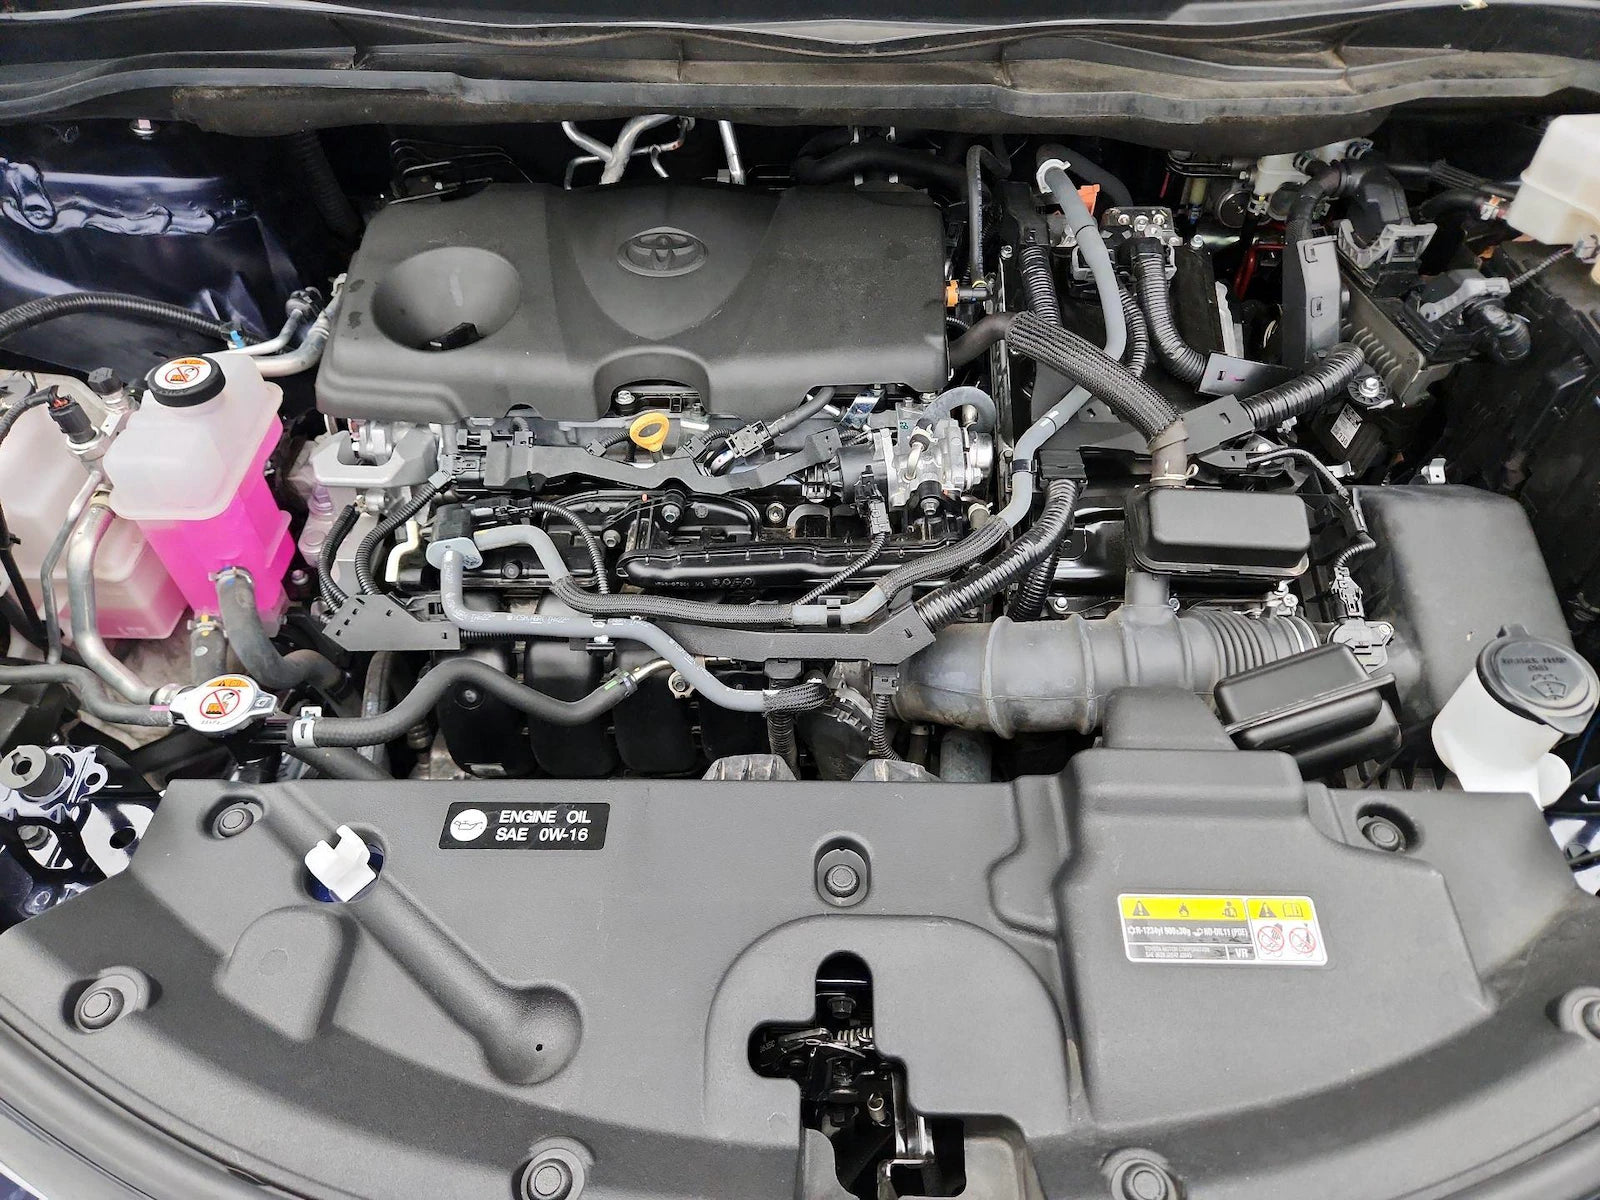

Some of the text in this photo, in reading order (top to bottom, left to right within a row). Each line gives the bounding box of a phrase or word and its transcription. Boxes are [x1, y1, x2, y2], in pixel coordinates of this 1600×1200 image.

[498, 810, 592, 824] ENGINE OIL
[495, 827, 588, 842] SAE 0W-16
[1234, 947, 1248, 958] VR
